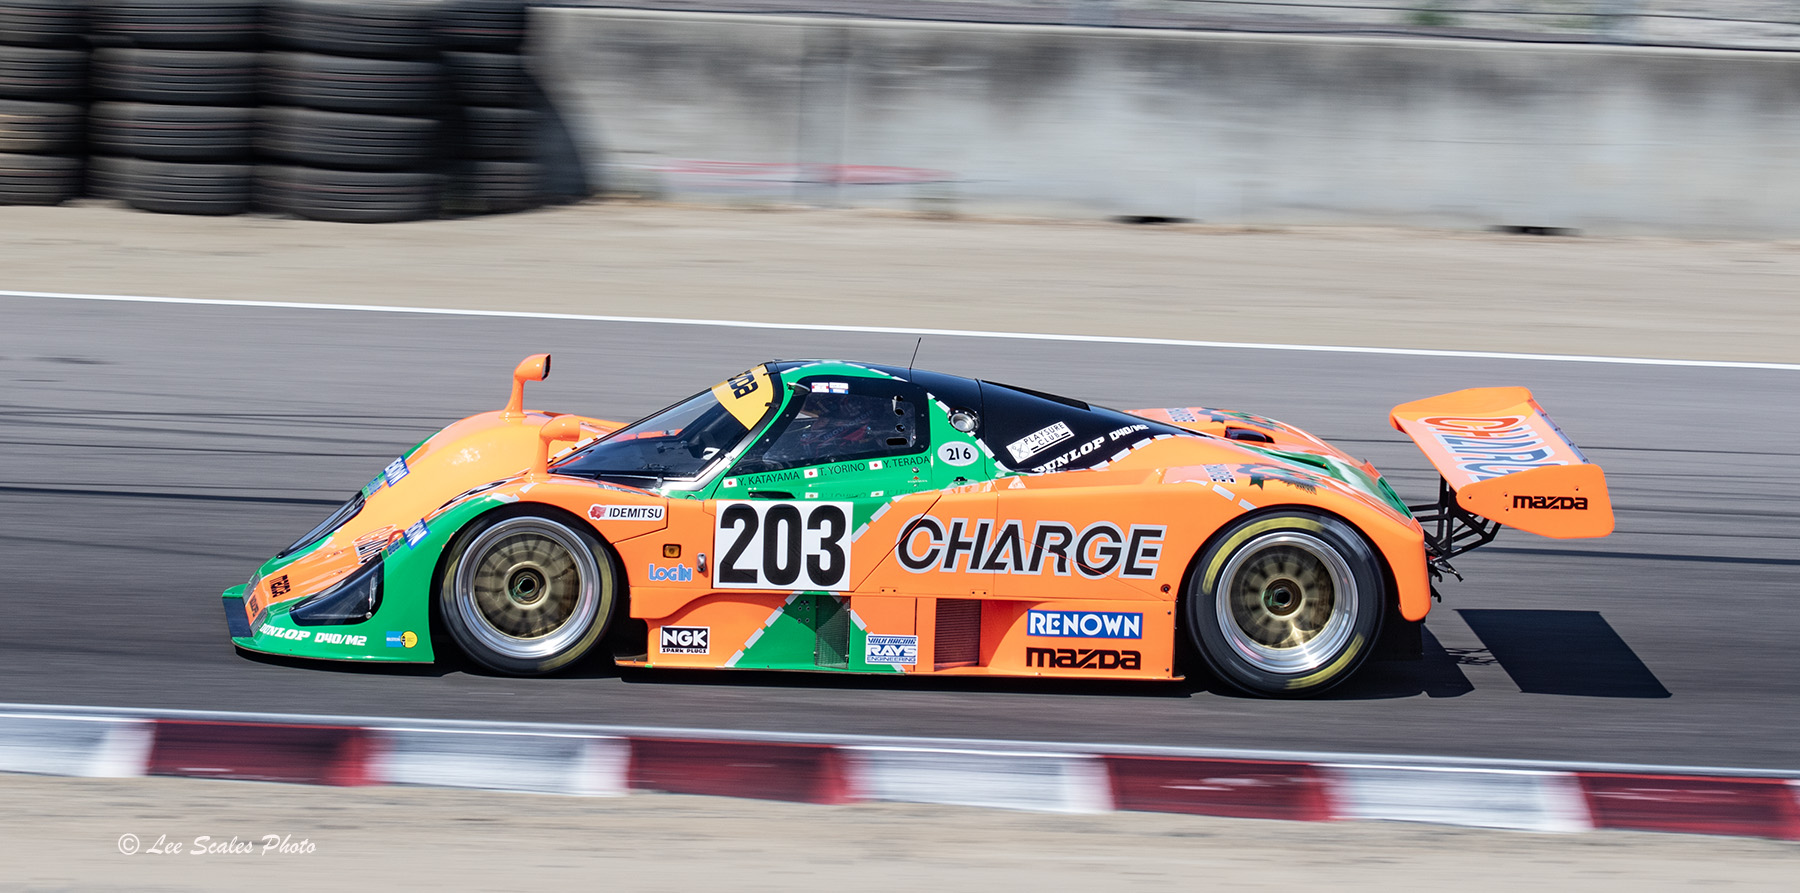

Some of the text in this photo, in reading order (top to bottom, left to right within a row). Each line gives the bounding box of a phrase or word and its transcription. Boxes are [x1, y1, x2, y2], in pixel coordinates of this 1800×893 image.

[1023, 422, 1066, 446] PLAYSURE
[1037, 432, 1061, 447] CLUB
[1031, 436, 1106, 474] DUNLOP
[1416, 415, 1569, 483] CHARG
[819, 462, 866, 477] T. YORINO
[883, 455, 931, 469] Y. TERADA
[738, 471, 801, 487] Y. KATAYAMA
[608, 507, 663, 519] IDEMITSU
[718, 503, 847, 587] 203
[895, 514, 1168, 581] CHARGE
[1028, 611, 1141, 638] RENOWN
[662, 630, 707, 647] NGK
[868, 645, 916, 657] RAYS
